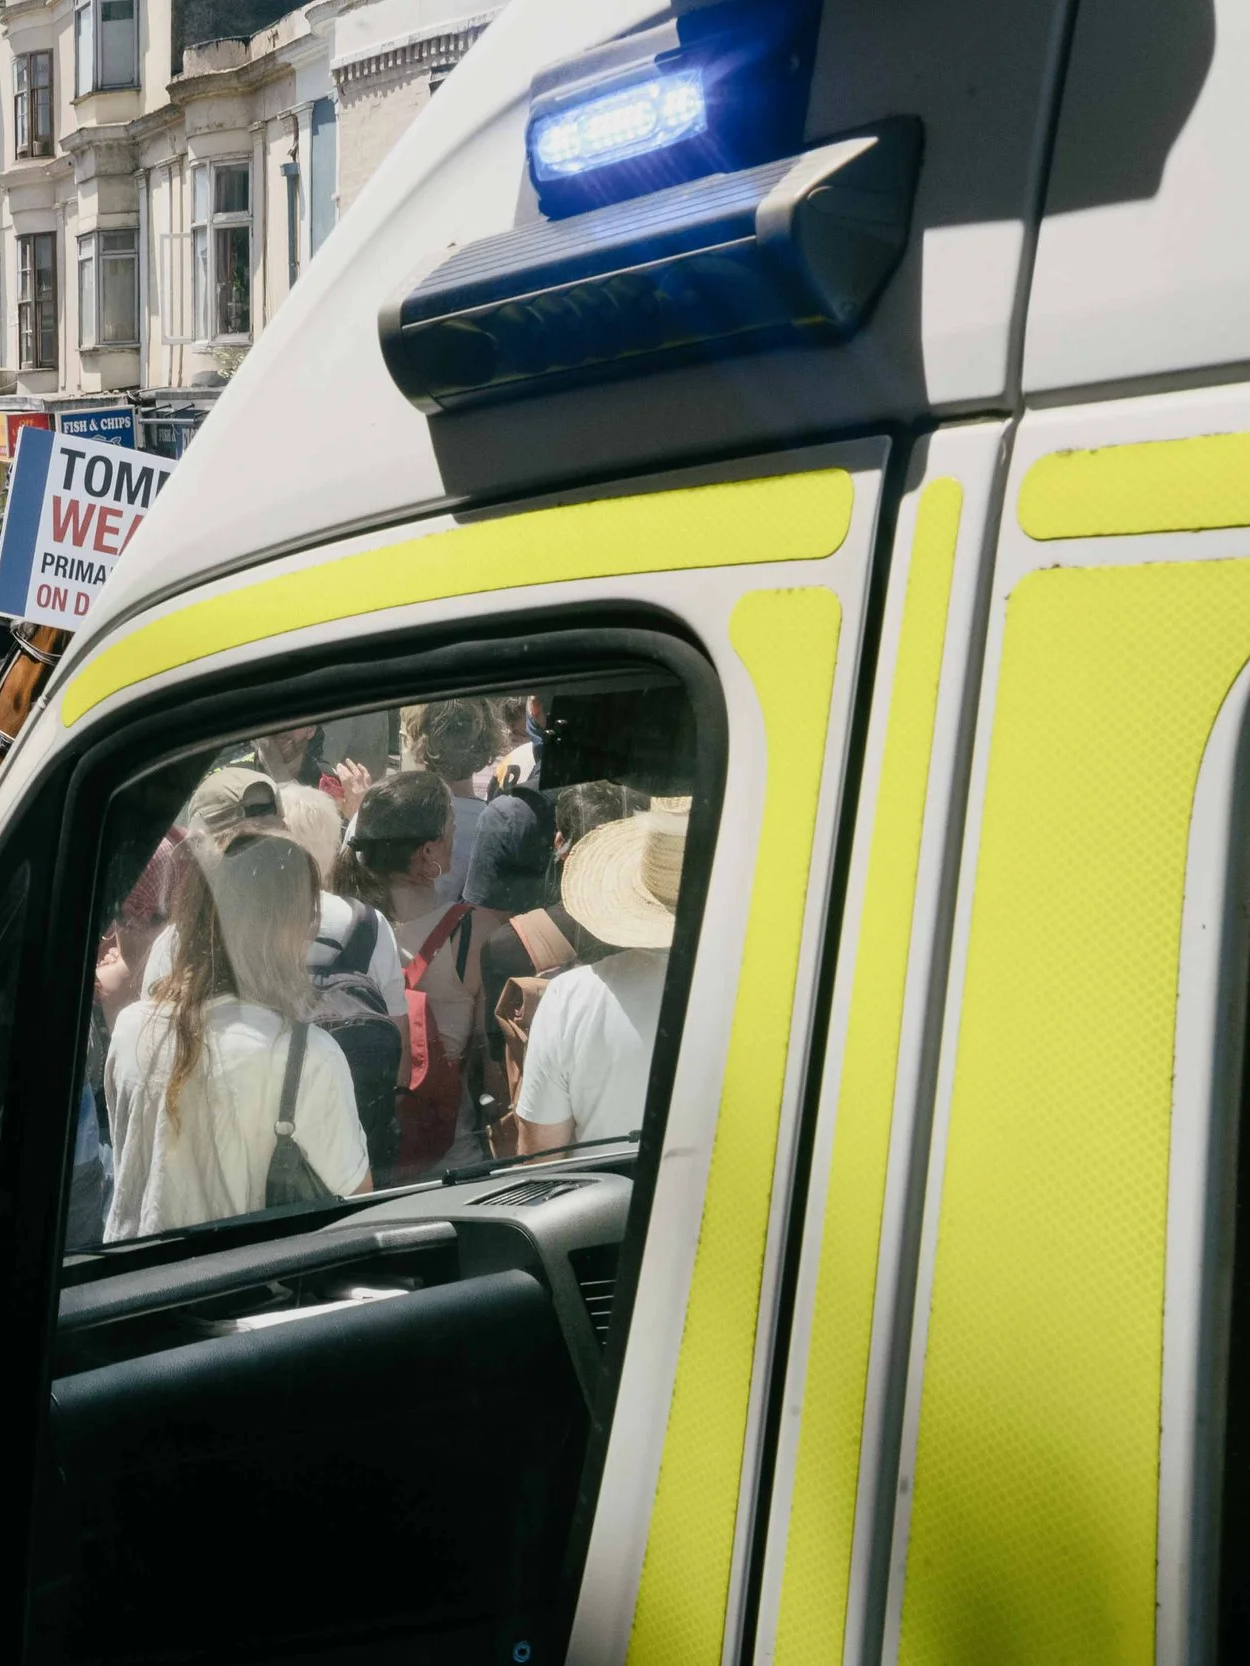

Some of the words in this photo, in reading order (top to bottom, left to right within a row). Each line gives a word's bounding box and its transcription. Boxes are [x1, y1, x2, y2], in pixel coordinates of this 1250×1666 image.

[63, 420, 87, 434] FISH
[89, 418, 98, 431] &
[100, 416, 132, 430] CHIPS
[40, 552, 113, 586] PRIMA
[36, 583, 68, 612] ON
